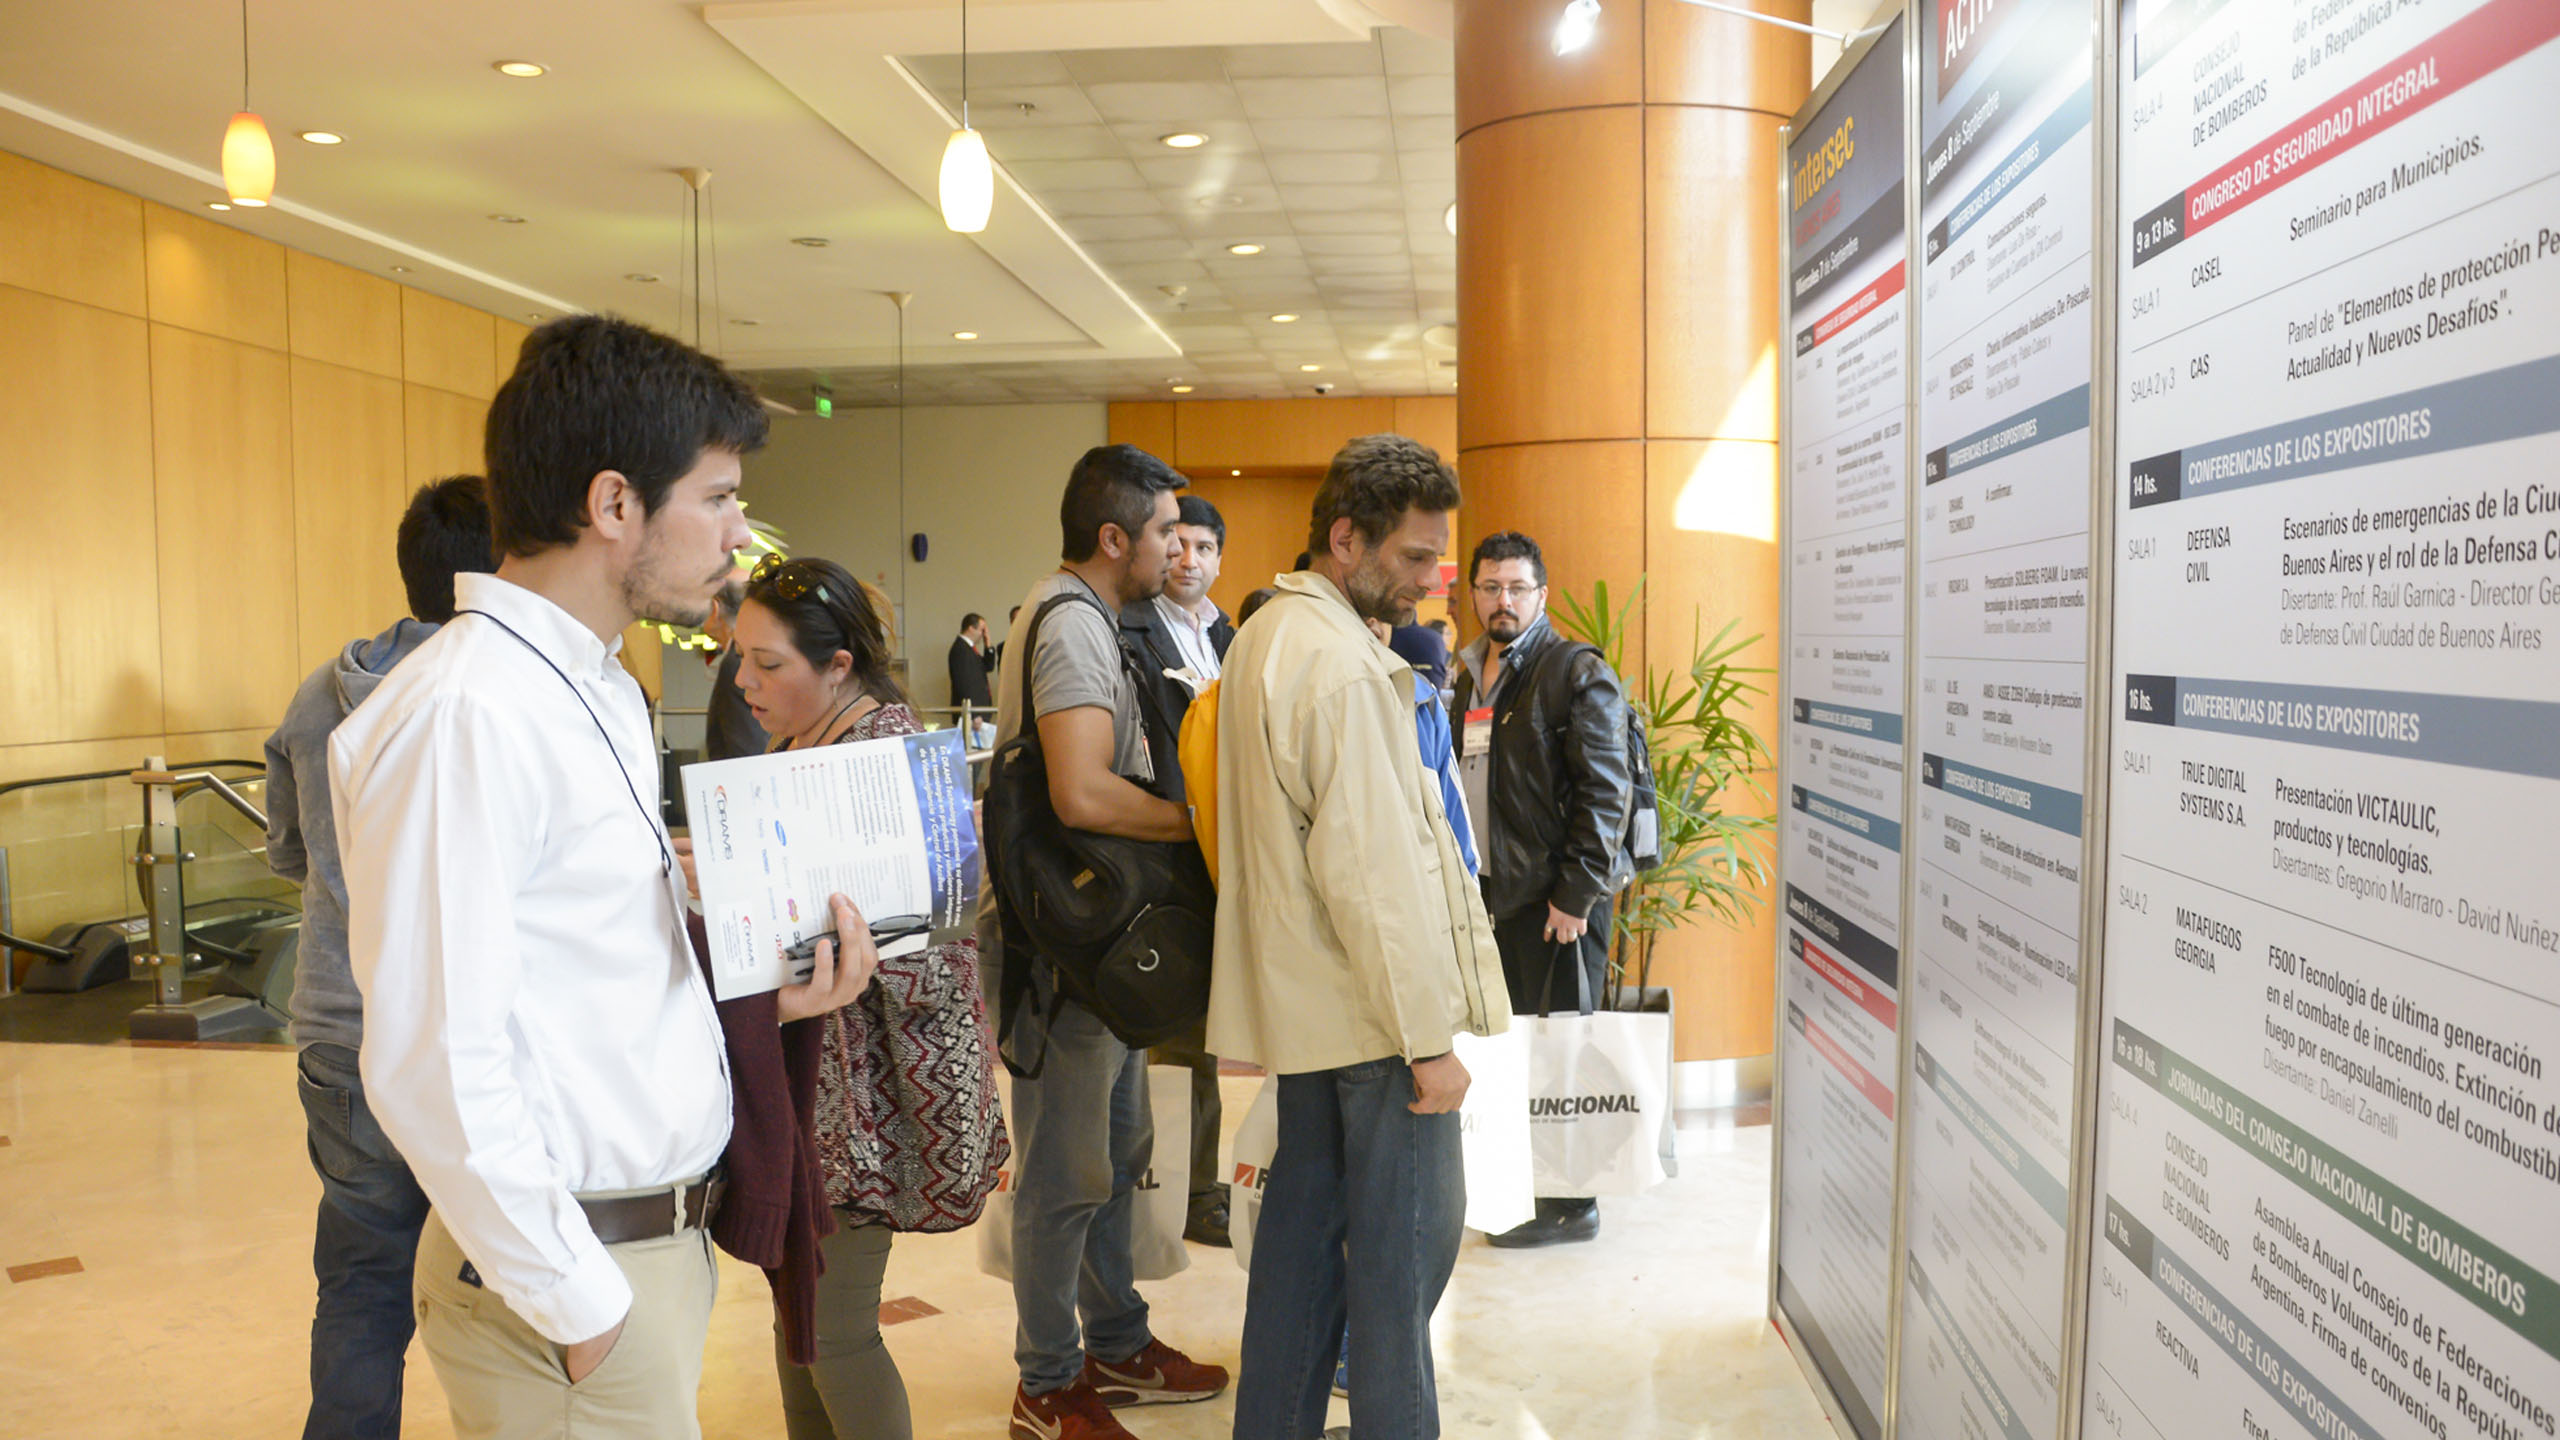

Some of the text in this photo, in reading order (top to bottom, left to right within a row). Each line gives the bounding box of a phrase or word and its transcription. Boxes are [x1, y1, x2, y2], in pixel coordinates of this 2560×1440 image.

[1927, 149, 1948, 185] Jueves
[1962, 91, 2000, 145] Septiembre
[2192, 56, 2439, 221] CONGRESO DE SEGURIDAD INTEGRAL
[2194, 79, 2267, 147] DE BOMBEROS
[1794, 116, 1854, 212] intersec
[2290, 134, 2484, 241] Seminario para Municipios.
[2192, 256, 2222, 288] CASEL
[2288, 238, 2531, 344] Panel de "Elementos de protección
[2190, 353, 2209, 379] CAS
[2287, 338, 2351, 382] Actualidad
[2356, 342, 2363, 367] y
[2368, 321, 2421, 357] Nuevos
[2188, 408, 2431, 485] CONFERENCIAS DE LOS EXPOSITORES
[2187, 526, 2231, 551] DEFENSA
[2284, 489, 2519, 540] Escenarios de emergencias de la
[2187, 562, 2210, 583] CIVIL
[2282, 534, 2537, 576] Buenos Aires y el rol de la Defensa
[2281, 578, 2533, 611] Disertante: Prof. Raúl Garnica Director
[2280, 621, 2541, 650] de Defensa Civil Ciudad de Buenos Aires
[2183, 693, 2420, 743] CONFERENCIAS DE LOS EXPOSITORES
[2181, 760, 2246, 793] TRUE DIGITAL
[2180, 792, 2246, 827] SYSTEMS S.A.
[2275, 777, 2440, 837] Presentación VICTAULIC,
[2274, 817, 2432, 876] productos y tecnologías.
[2176, 907, 2242, 951] MATAFUEGOS
[2273, 847, 2560, 953] Disertantes: Gregorio Marraro David Nuñez
[2174, 938, 2215, 974] GEORGIA
[2268, 945, 2542, 1080] F500 Tecnología de última generación
[2265, 1015, 2295, 1050] fuego
[2298, 1035, 2316, 1059] por
[2320, 1047, 2432, 1118] encapsulamiento
[2437, 1100, 2460, 1133] del
[2266, 985, 2537, 1125] en el combate de incendios. Extinción
[1529, 1094, 1640, 1116] UNCIONAL
[2165, 1131, 2207, 1178] CONSEJO
[2164, 1161, 2211, 1214] NACIONAL
[2168, 1067, 2526, 1317] JORNADAS DEL CONSEJO NACIONAL DE BOMBEROS
[2163, 1191, 2230, 1261] DE BOMBEROS
[2253, 1231, 2450, 1403] de Bomberos Voluntarios de la
[2254, 1197, 2555, 1437] Asamblea Anual Consejo de Federaciones
[2156, 1320, 2200, 1380] REACTIVA
[2250, 1263, 2446, 1440] Argentina. Firma de convenios
